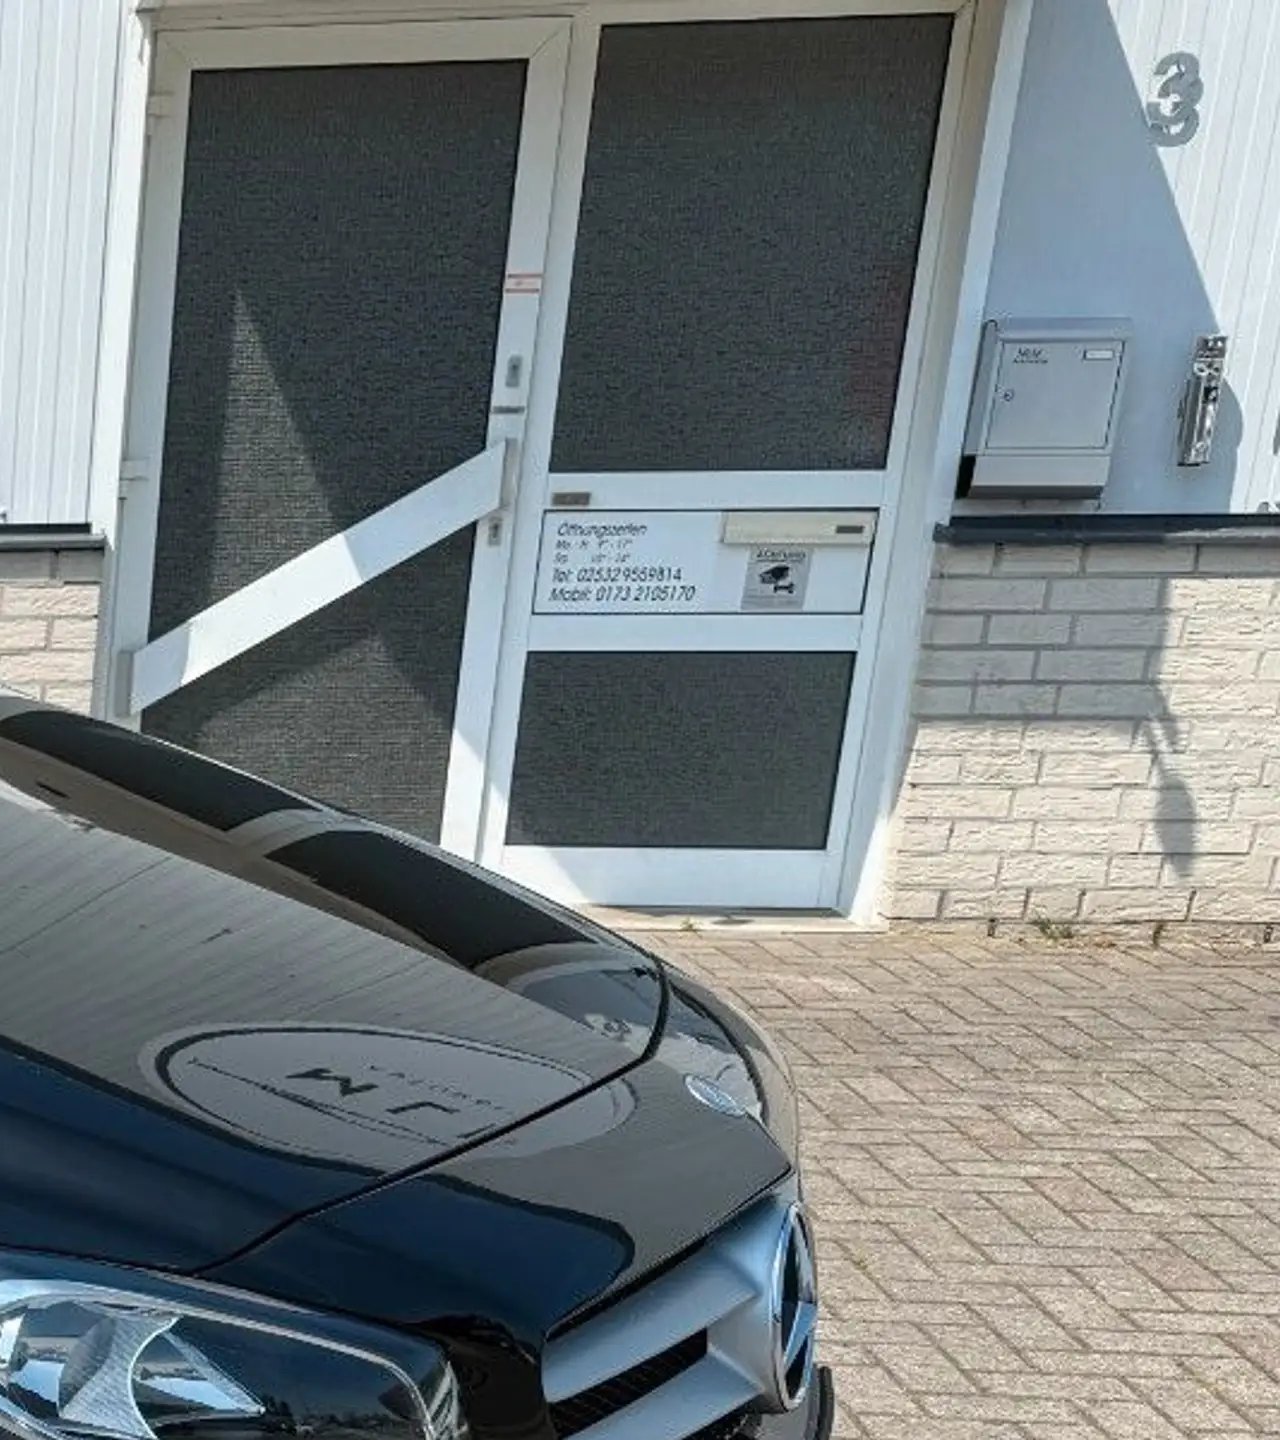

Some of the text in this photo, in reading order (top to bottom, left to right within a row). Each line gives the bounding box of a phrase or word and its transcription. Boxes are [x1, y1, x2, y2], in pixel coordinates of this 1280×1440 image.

[1146, 52, 1202, 134] 3
[595, 586, 631, 601] 0173
[634, 585, 696, 601] 2105170
